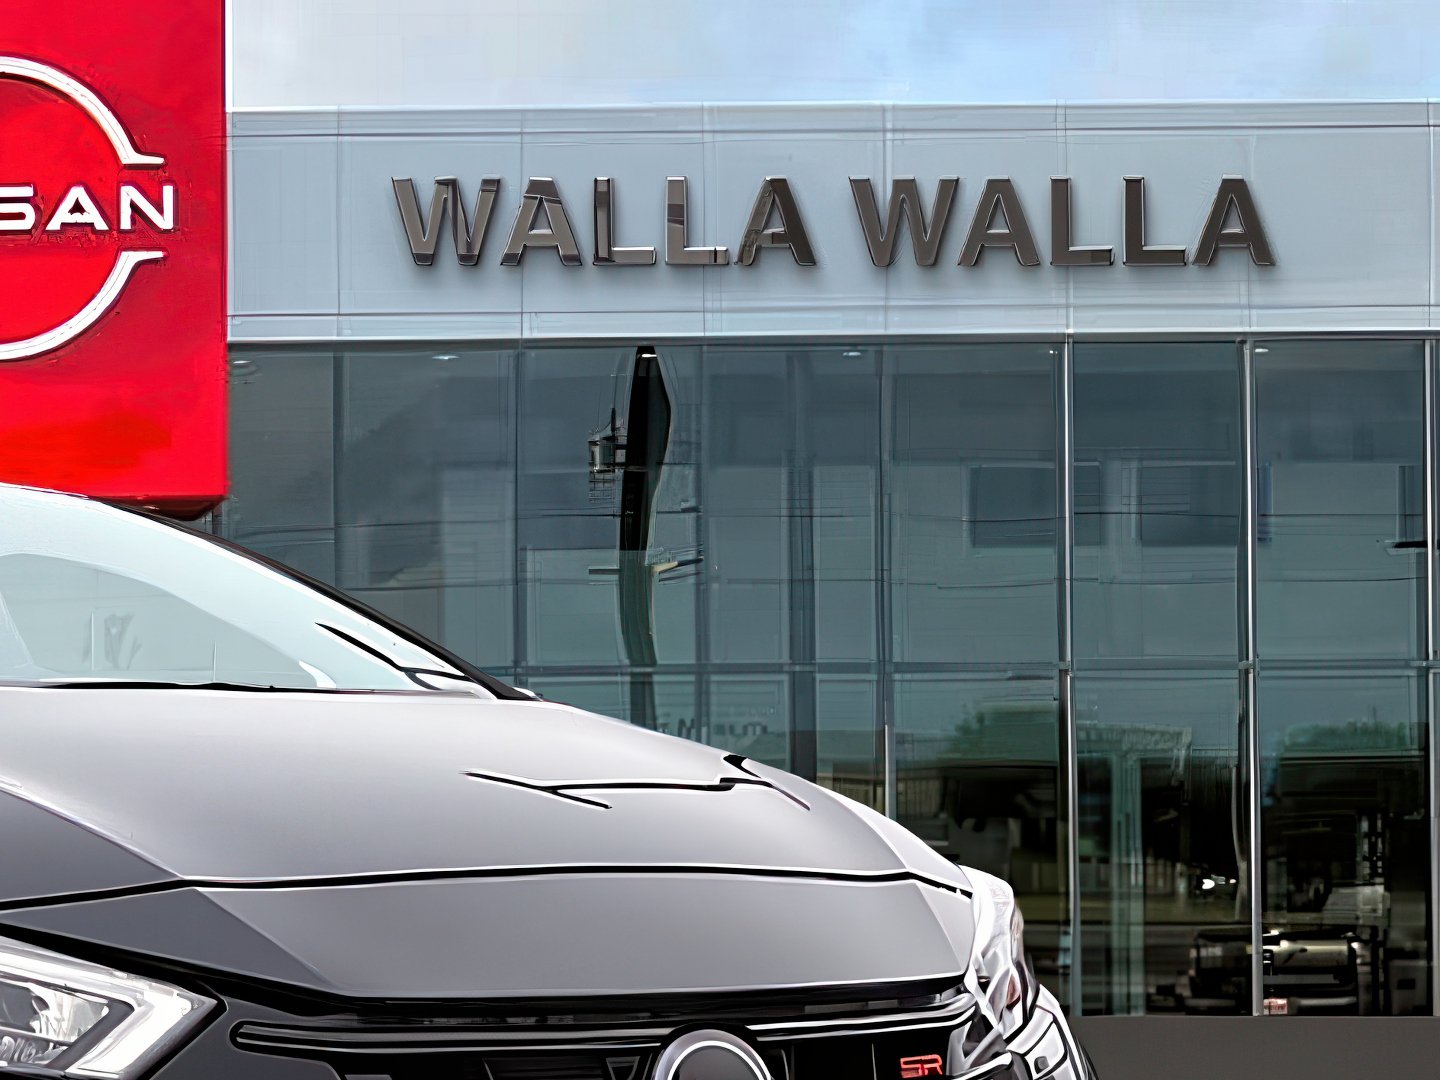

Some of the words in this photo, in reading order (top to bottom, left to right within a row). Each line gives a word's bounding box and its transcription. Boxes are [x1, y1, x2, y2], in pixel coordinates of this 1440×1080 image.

[390, 175, 817, 267] WALLA
[848, 175, 1275, 267] WALLA
[900, 1053, 943, 1079] SR
